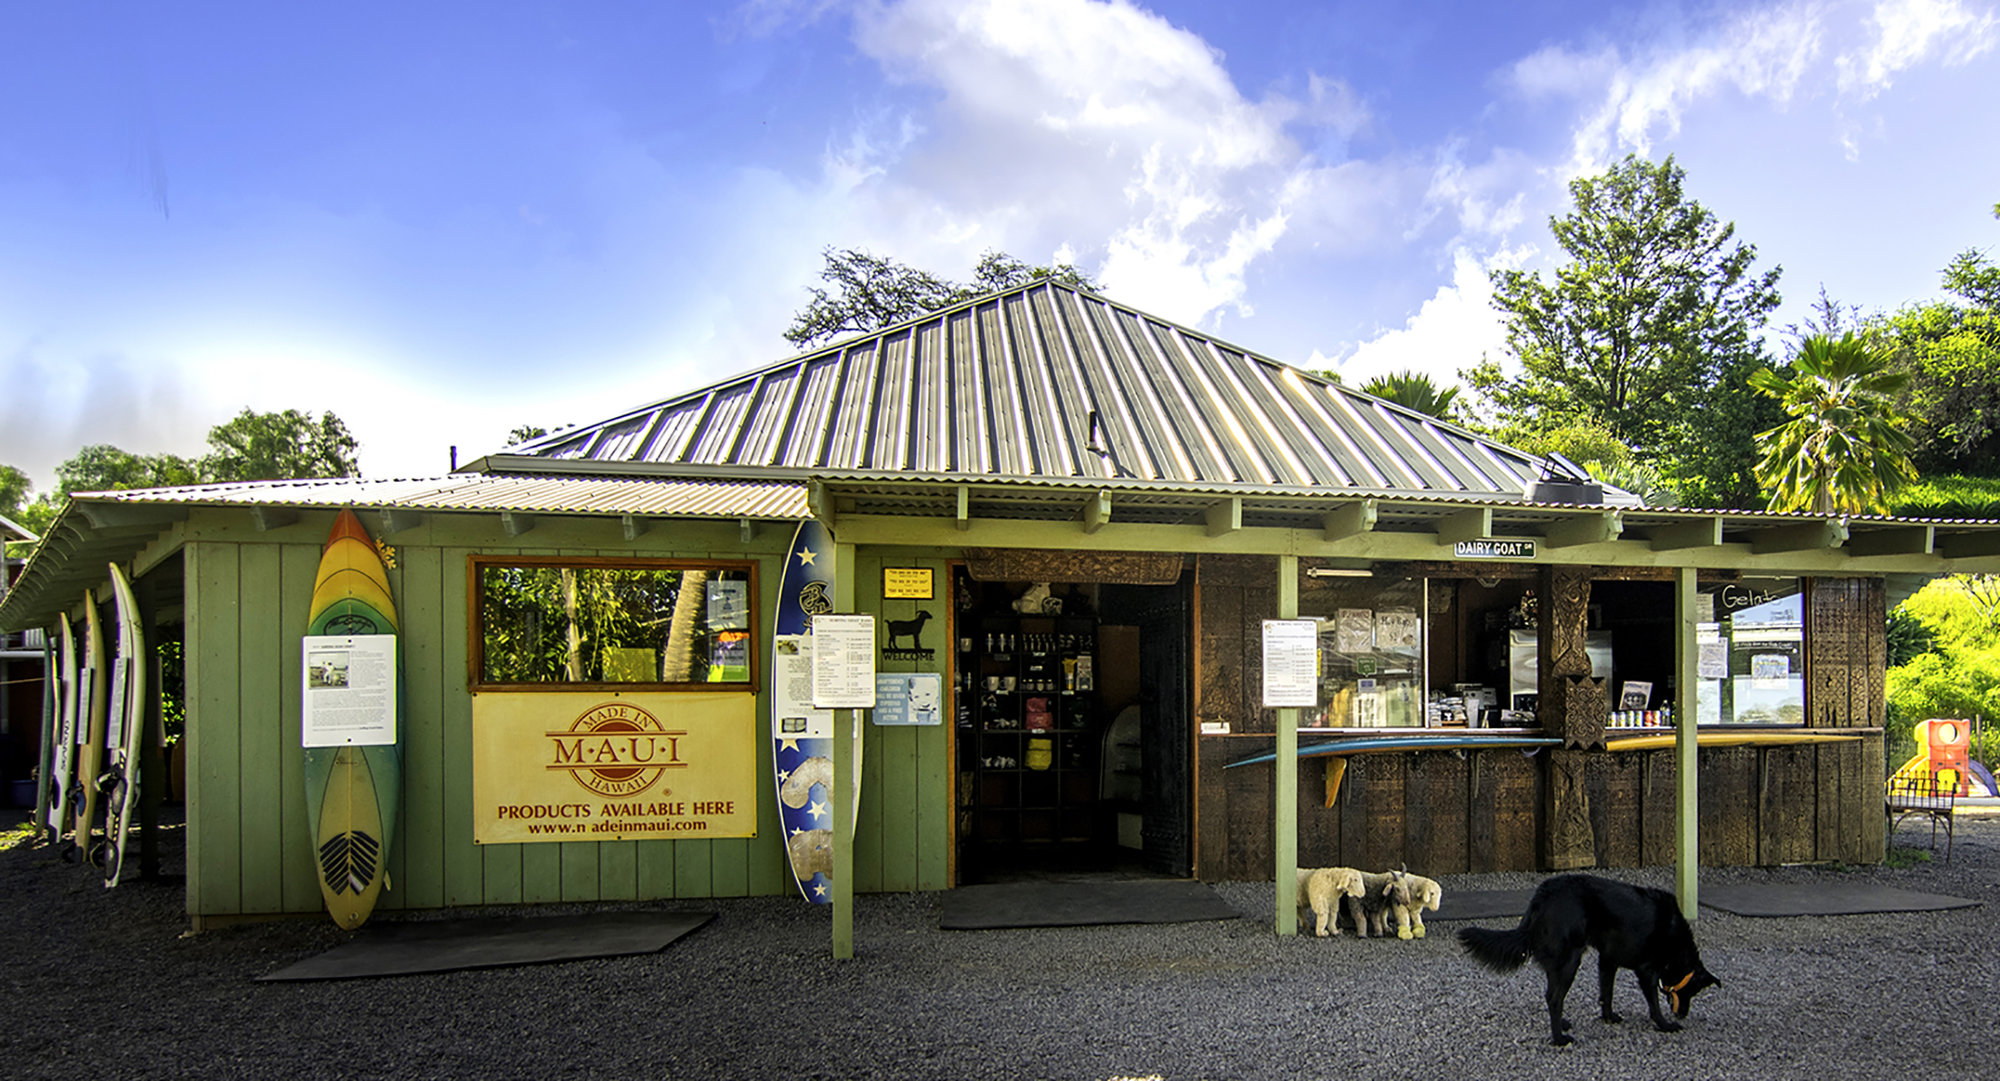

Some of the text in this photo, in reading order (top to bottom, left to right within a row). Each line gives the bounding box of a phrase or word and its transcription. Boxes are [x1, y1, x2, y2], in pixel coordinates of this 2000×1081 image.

[1458, 541, 1491, 554] DAIRY
[1493, 542, 1522, 555] GOAT
[883, 652, 935, 661] WELCOME
[582, 707, 652, 729] MADE IN
[589, 776, 647, 793] HAWAII
[498, 801, 734, 819] PRODUCTS AVAILABLE HERE
